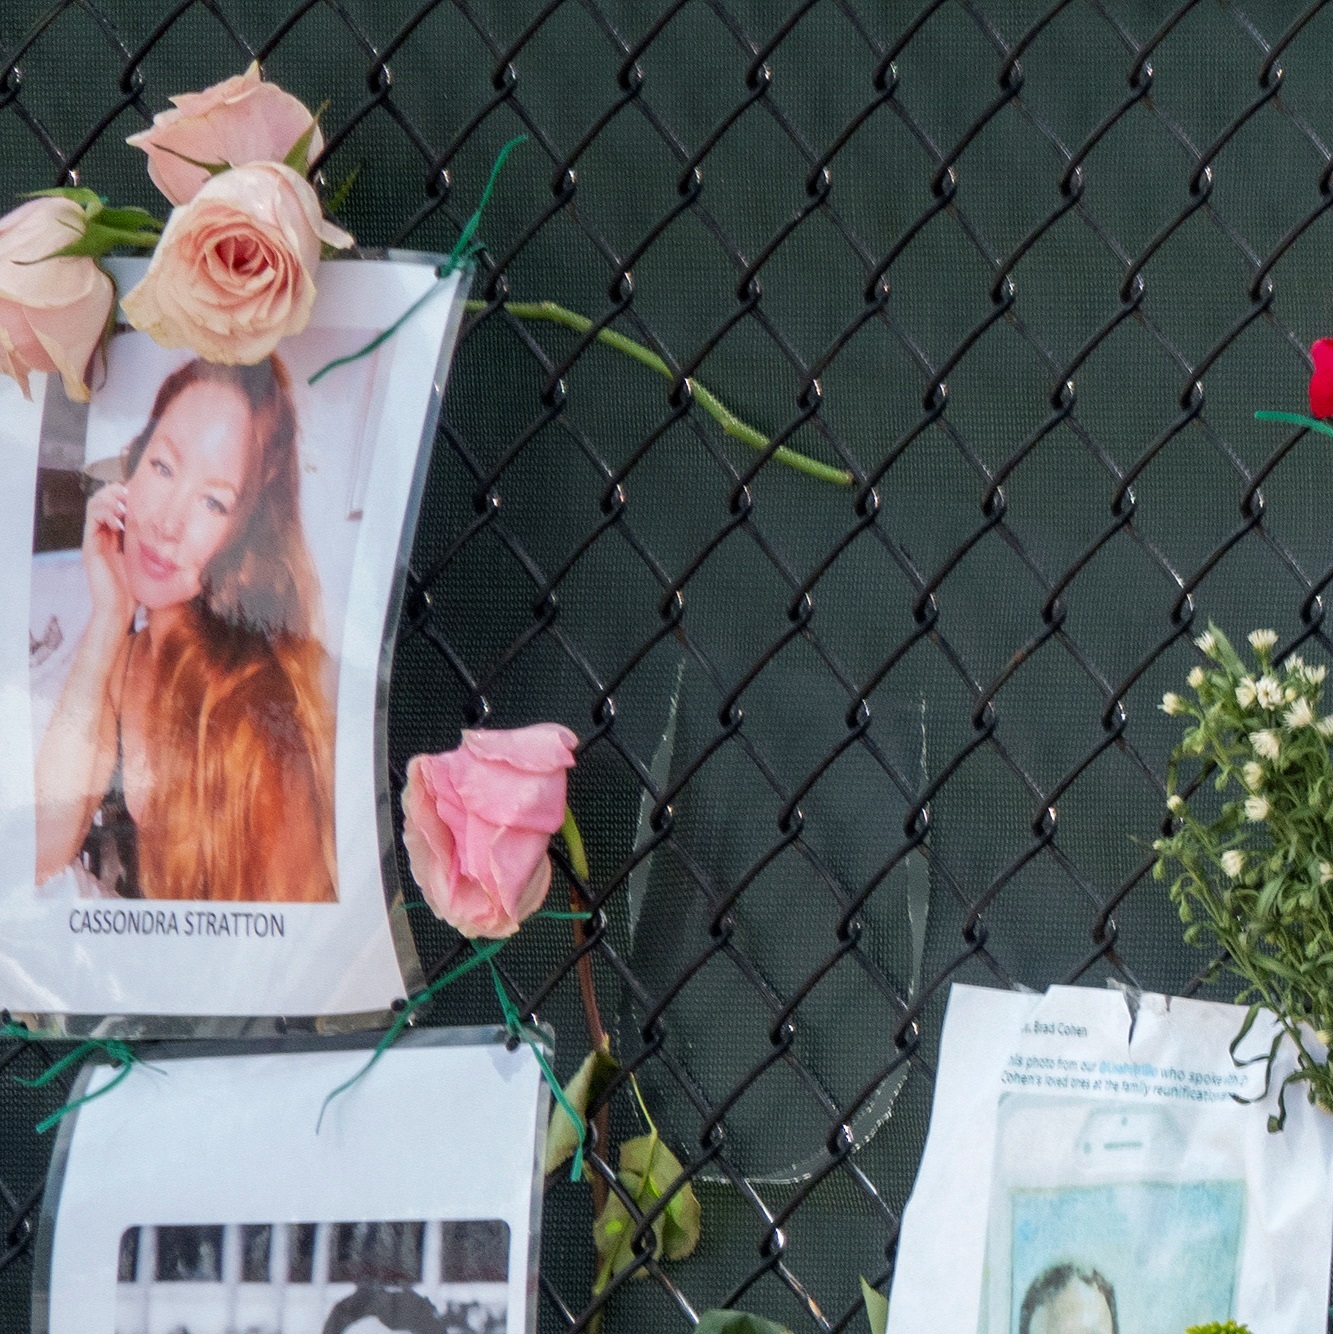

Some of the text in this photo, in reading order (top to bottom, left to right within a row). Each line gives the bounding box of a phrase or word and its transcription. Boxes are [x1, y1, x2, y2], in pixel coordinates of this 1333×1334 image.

[69, 908, 286, 938] CASSONDRA STRATTON
[1161, 1067, 1185, 1081] who
